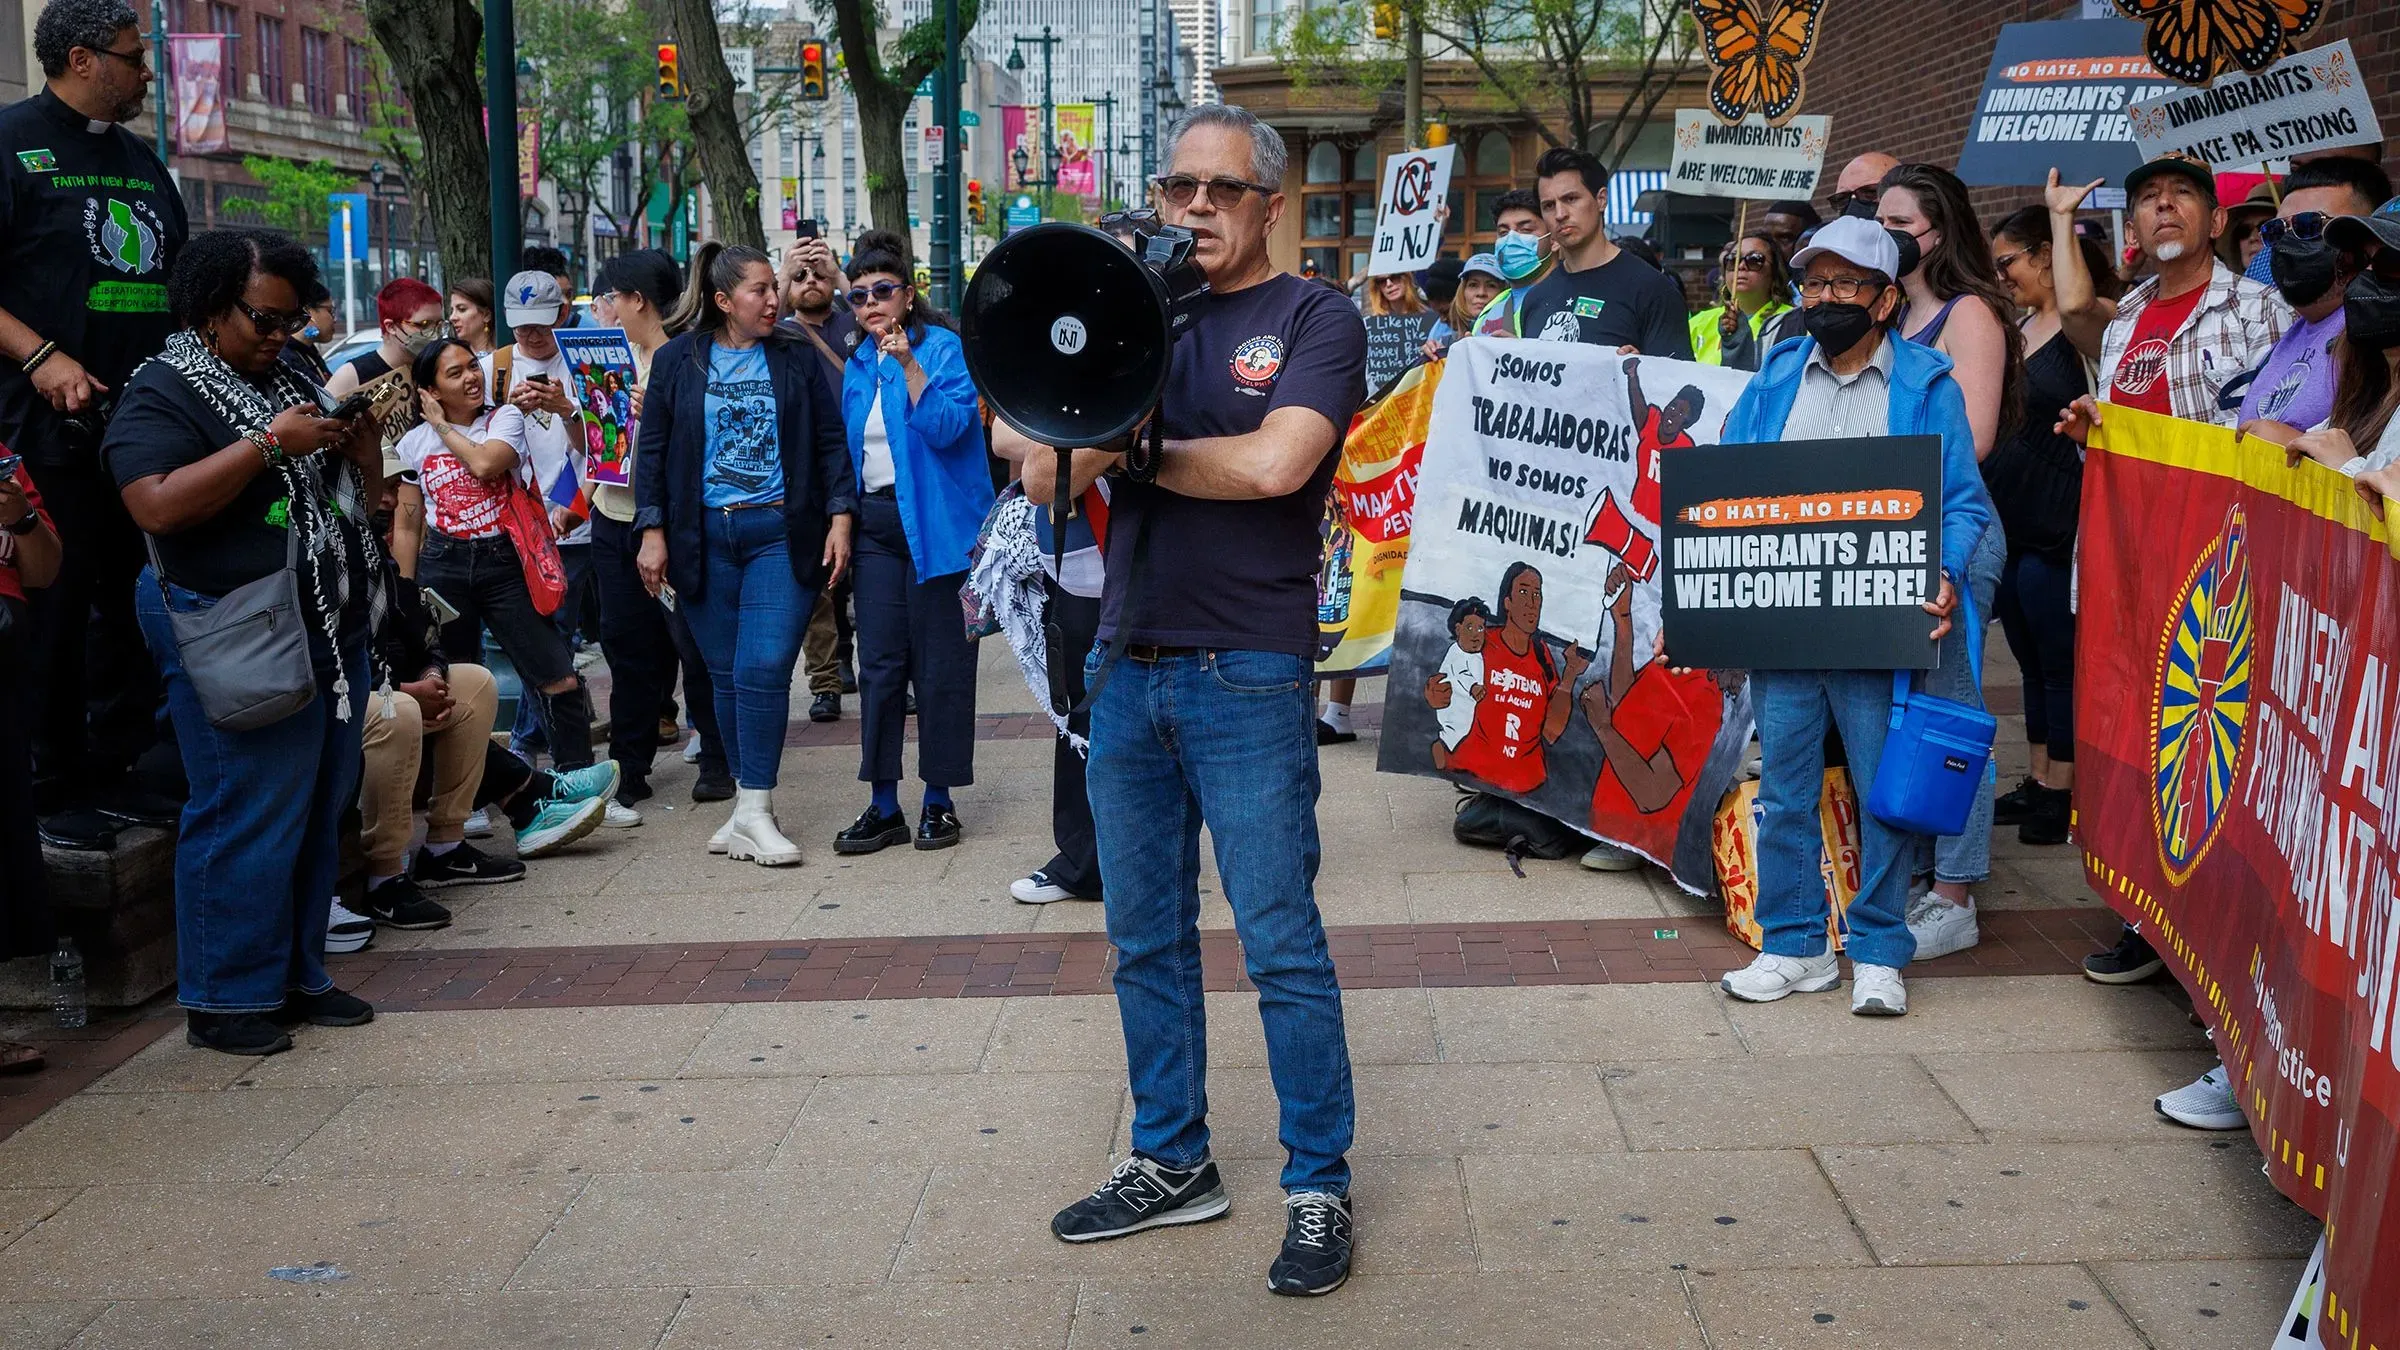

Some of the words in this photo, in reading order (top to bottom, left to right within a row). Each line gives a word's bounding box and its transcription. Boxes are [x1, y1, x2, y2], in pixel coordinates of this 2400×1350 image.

[724, 52, 746, 62] ONE
[2007, 66, 2029, 78] NO
[2035, 63, 2082, 77] HATE,
[2090, 64, 2114, 75] NO
[2120, 62, 2157, 74] FEA
[1984, 86, 2126, 112] IMMIGRANTS
[2164, 65, 2313, 128] IMMIGRANTS
[1705, 125, 1802, 148] IMMIGRANTS
[1977, 114, 2092, 142] WELCOME
[2177, 137, 2231, 164] AKE
[2231, 129, 2264, 157] PA
[2265, 107, 2358, 150] STRONG
[52, 176, 85, 189] FAITH
[87, 175, 99, 187] IN
[101, 176, 124, 187] NEW
[126, 178, 155, 193] JERSEY
[1677, 160, 1706, 181] ARE
[1710, 163, 1777, 188] WELCOME
[1778, 169, 1815, 190] HERE
[1379, 232, 1393, 253] in
[1399, 223, 1434, 261] NJ
[1377, 315, 1402, 329] Like
[1368, 330, 1400, 344] tates
[1405, 329, 1427, 341] like
[566, 347, 631, 364] POWER
[1367, 346, 1399, 361] hiskey
[1491, 353, 1566, 387] ¡SOMOS
[709, 383, 735, 392] MAKE
[738, 382, 756, 390] THE
[1472, 396, 1631, 463] TRABAJADORAS
[1489, 456, 1512, 481] NO
[1516, 464, 1588, 499] SOMOS
[1688, 506, 1718, 521] NO
[1726, 503, 1790, 521] HATE,
[1800, 502, 1832, 517] NO
[1842, 500, 1911, 515] FEAR:
[1457, 497, 1579, 559] MAQUINAS!
[1674, 532, 1858, 569] IMMIGRANTS
[1866, 530, 1927, 565] ARE
[1674, 571, 1821, 609] WELCOME
[1832, 569, 1927, 606] HERE!
[1495, 694, 1506, 703] EN
[1505, 713, 1521, 741] R
[2243, 701, 2283, 835] FOR
